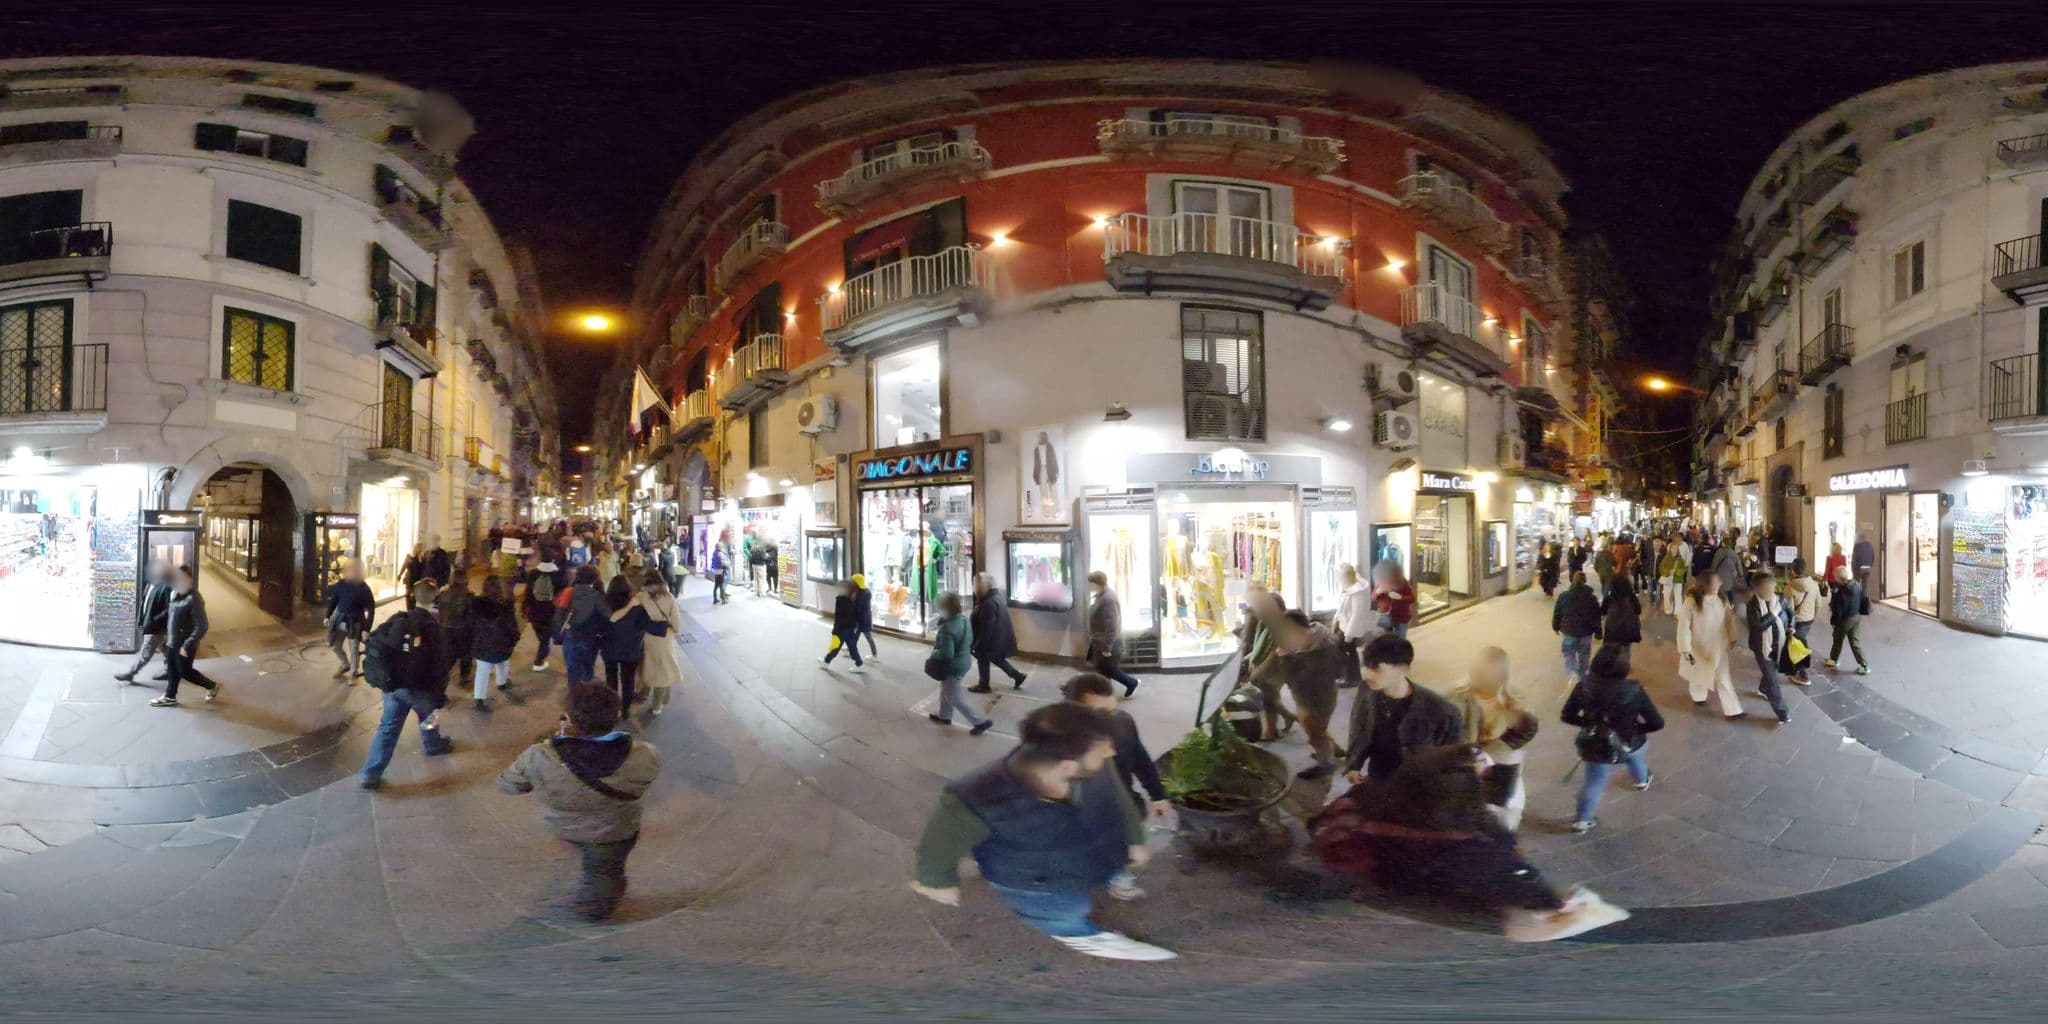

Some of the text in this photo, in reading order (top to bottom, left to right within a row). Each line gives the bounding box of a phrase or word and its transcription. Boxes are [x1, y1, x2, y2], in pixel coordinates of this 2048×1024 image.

[855, 449, 970, 479] DIAGONALE
[1423, 473, 1450, 489] Mara
[1830, 468, 1906, 491] CALZEDONIA
